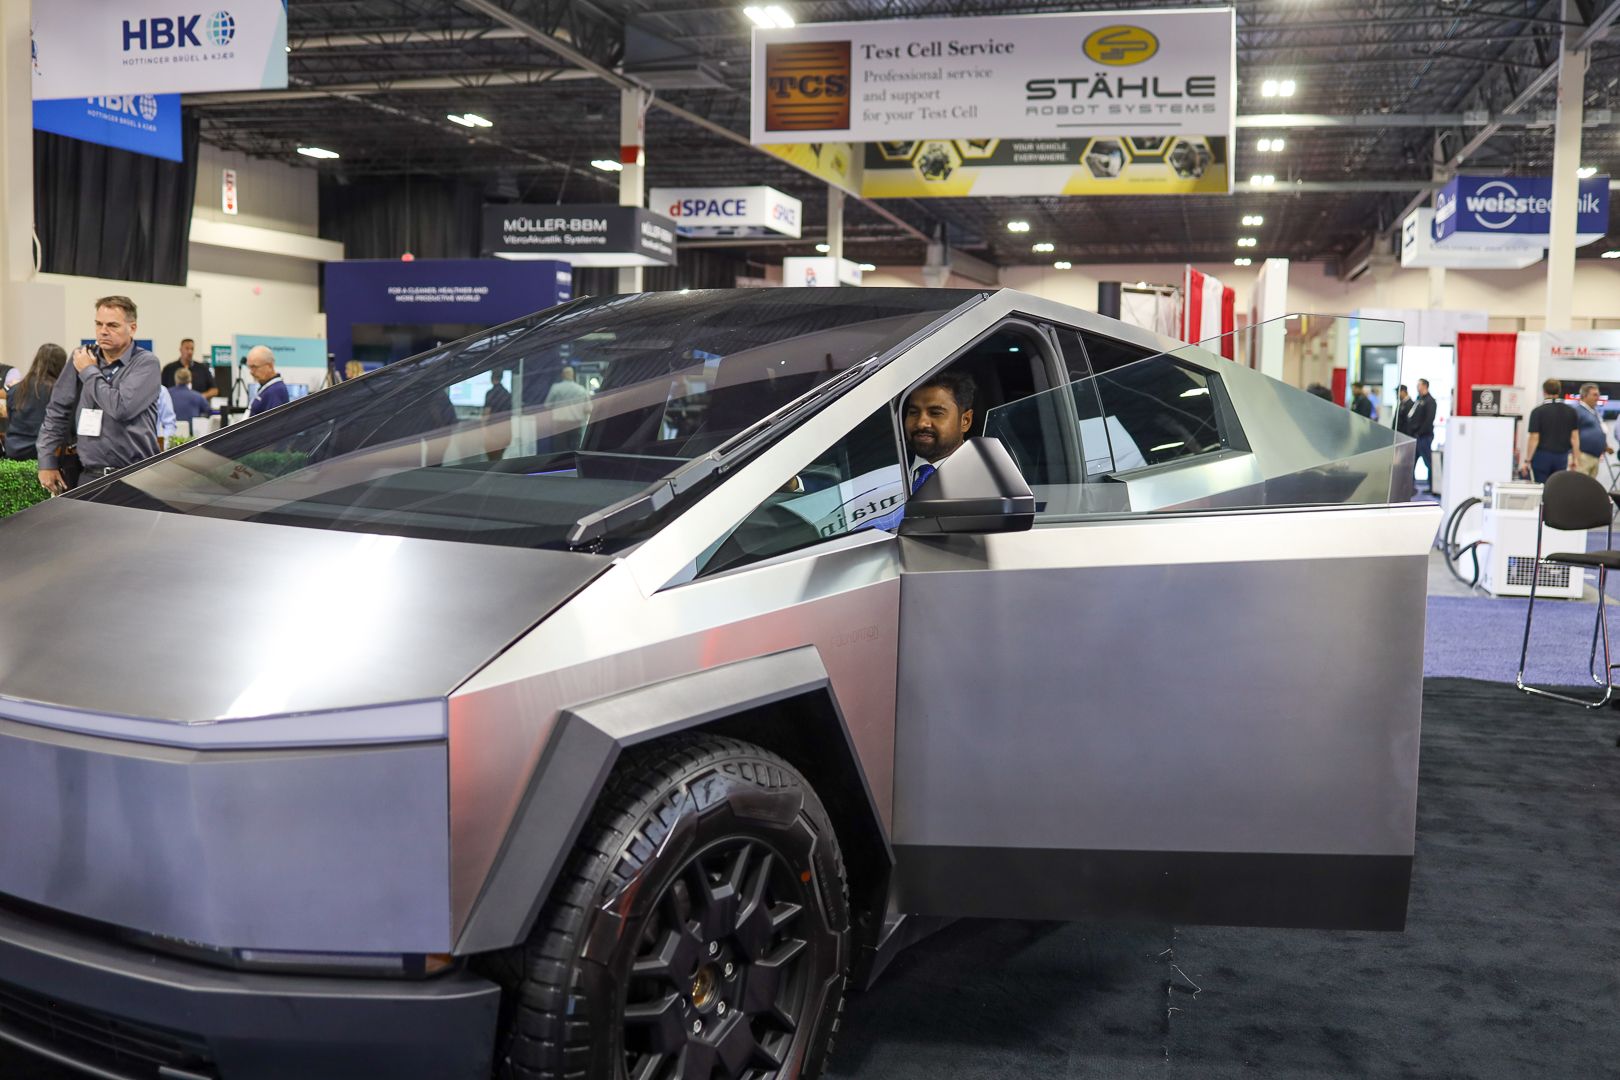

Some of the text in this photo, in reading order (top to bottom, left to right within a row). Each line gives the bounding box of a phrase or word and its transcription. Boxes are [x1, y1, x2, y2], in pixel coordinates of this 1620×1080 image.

[122, 14, 202, 51] HBK
[861, 38, 1015, 60] Test Cell Service
[122, 56, 170, 66] HOTTINGER
[173, 54, 200, 63] BRÜEL
[863, 68, 994, 83] Professional service
[768, 74, 848, 99] TCS
[1025, 72, 1216, 101] STÄHLE
[863, 89, 940, 104] and support
[862, 105, 978, 125] for your Test Cell
[1025, 103, 1216, 116] ROBOT SYSTEMS
[669, 199, 746, 217] dSPACE
[1466, 192, 1600, 214] weissteik
[503, 217, 607, 232] MÜLLER-BBM
